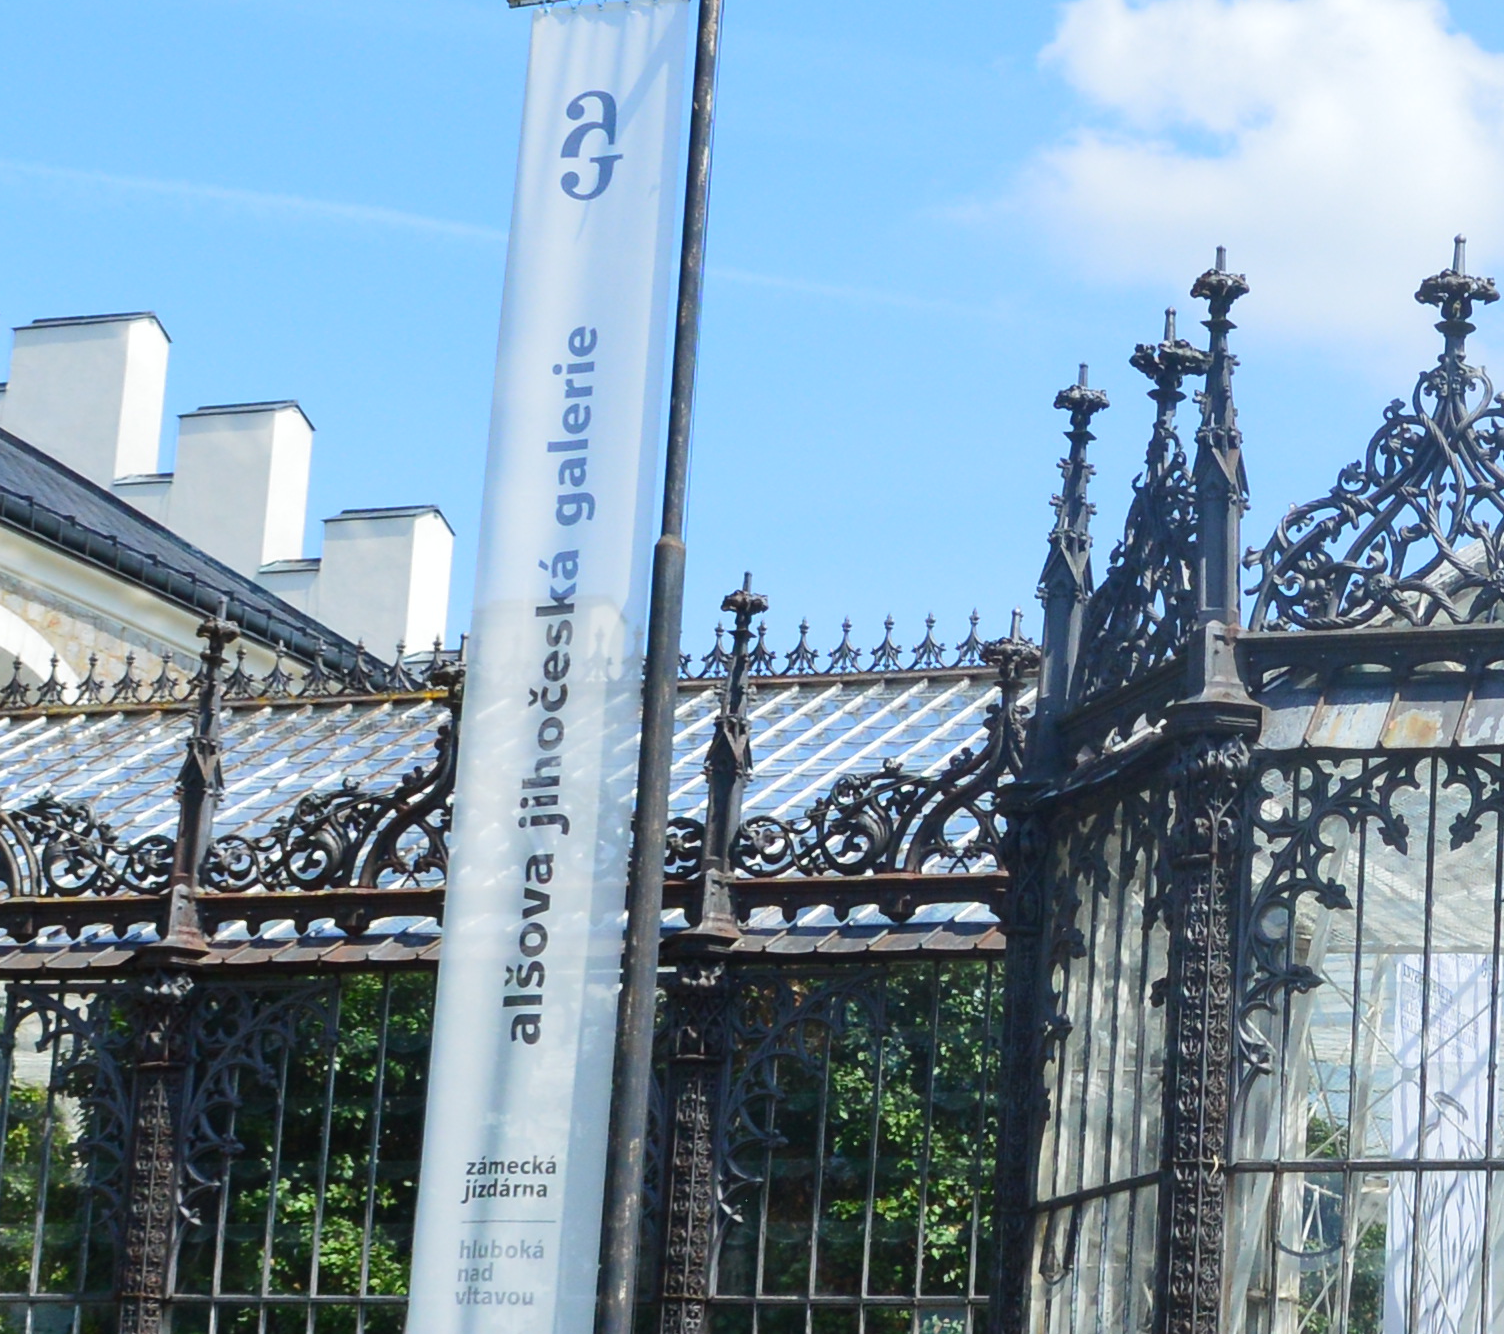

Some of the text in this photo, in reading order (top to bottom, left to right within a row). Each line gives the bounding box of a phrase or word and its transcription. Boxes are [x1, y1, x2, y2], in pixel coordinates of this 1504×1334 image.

[503, 325, 598, 1045] alšova jihočeská galerie
[466, 1155, 557, 1175] zámecká
[460, 1178, 548, 1204] jízdárna
[459, 1239, 545, 1259] hluboká
[457, 1262, 494, 1282] nad
[455, 1286, 535, 1306] vltavou
